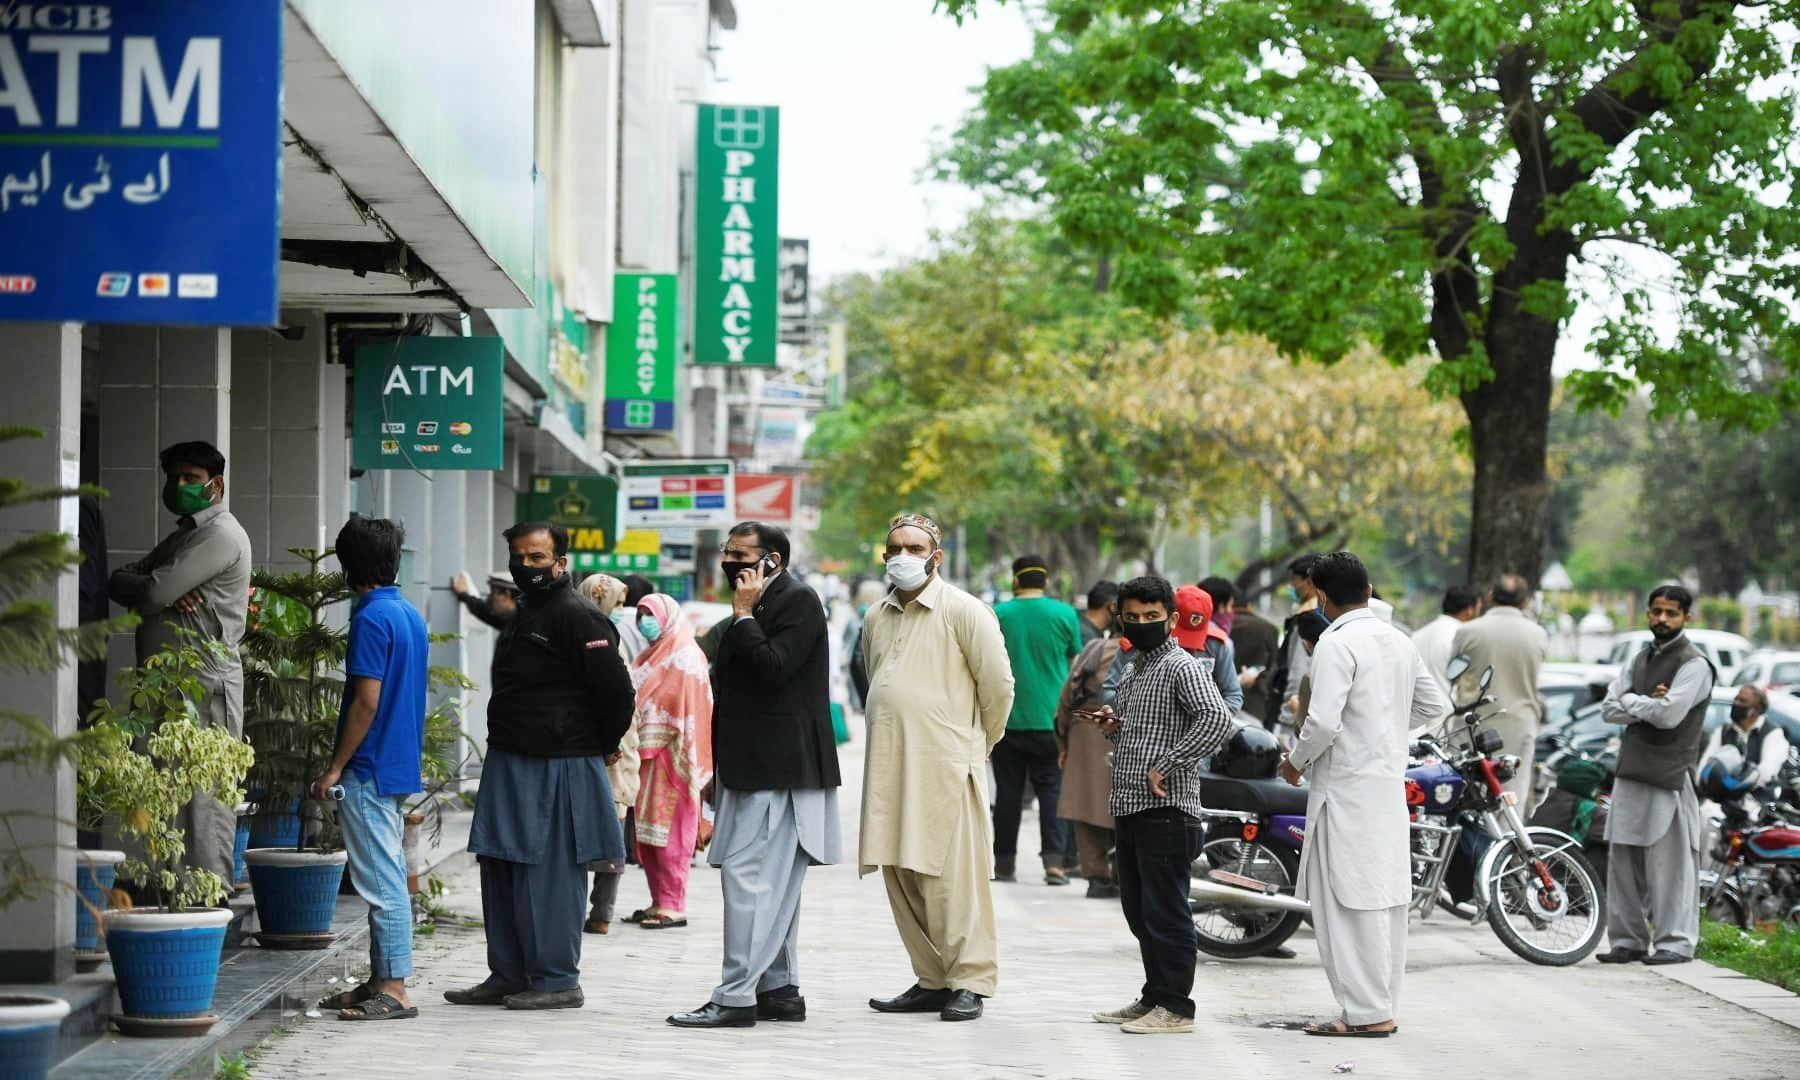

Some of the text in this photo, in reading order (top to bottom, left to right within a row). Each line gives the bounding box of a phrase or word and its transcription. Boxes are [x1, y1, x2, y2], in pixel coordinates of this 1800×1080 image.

[0, 4, 112, 30] MCB
[720, 150, 756, 362] PHARMACY
[636, 277, 658, 395] PHARMACY
[383, 364, 474, 396] ATM
